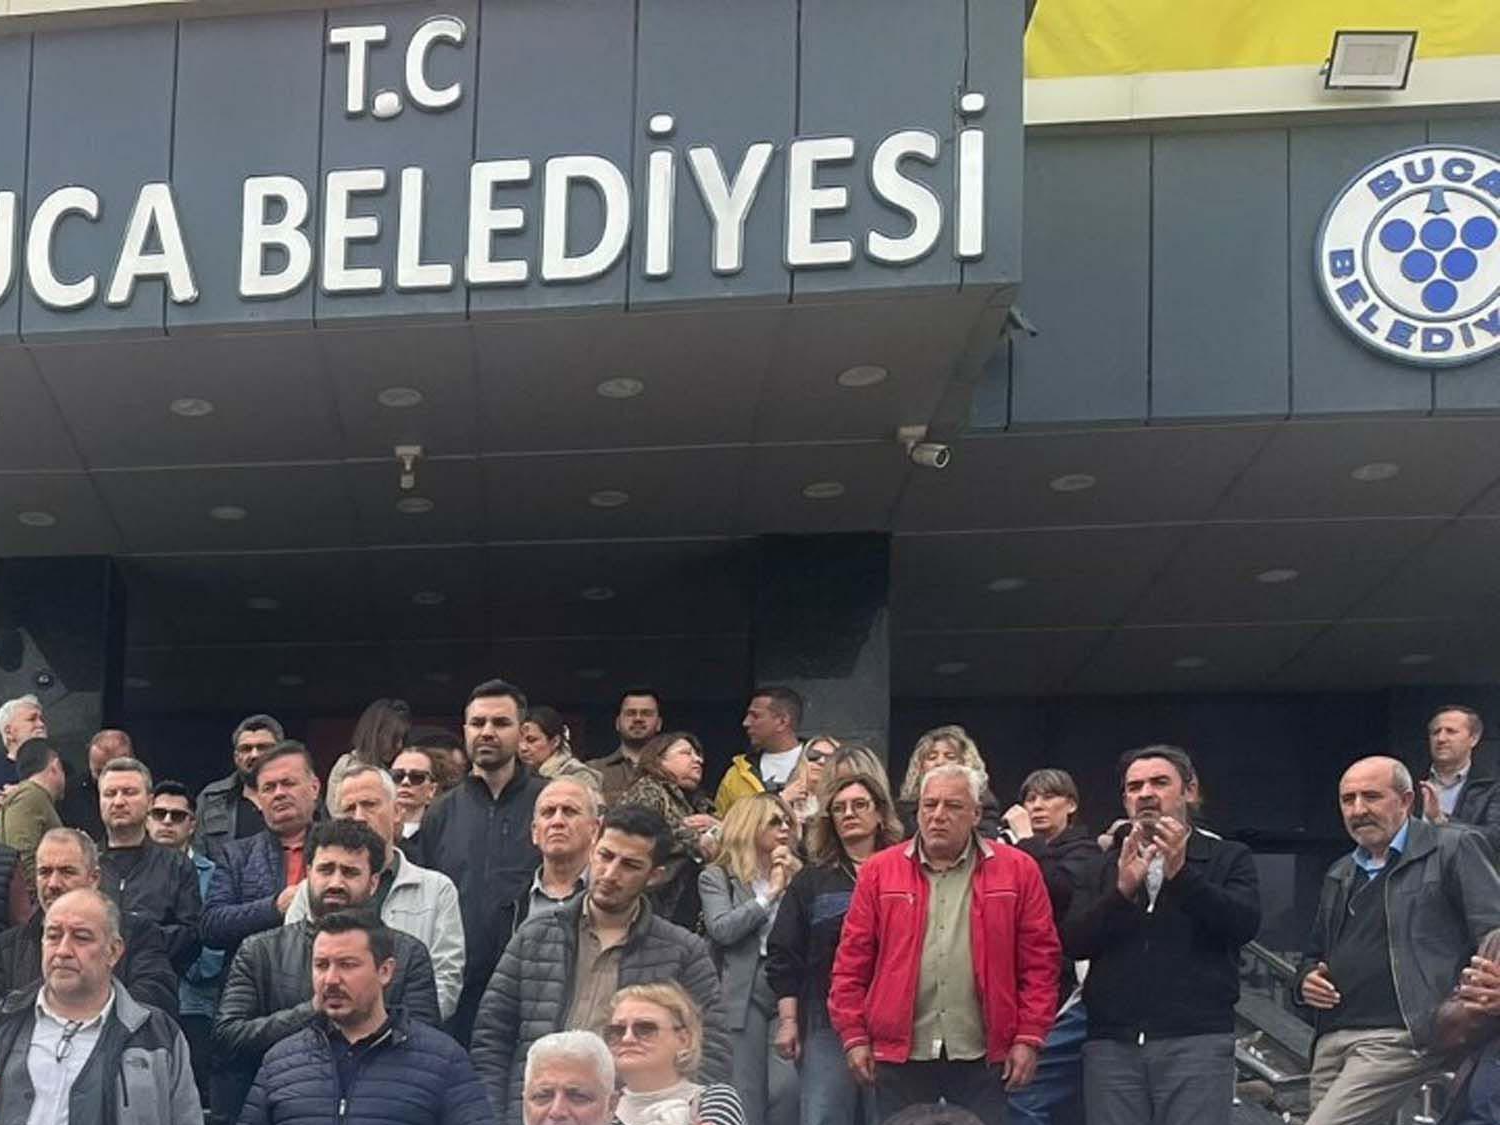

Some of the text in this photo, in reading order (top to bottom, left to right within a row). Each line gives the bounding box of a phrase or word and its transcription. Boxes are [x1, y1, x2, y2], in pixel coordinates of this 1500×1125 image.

[329, 17, 466, 119] T.C
[239, 92, 987, 297] BELEDİYESİ
[1367, 157, 1500, 201] BUCA
